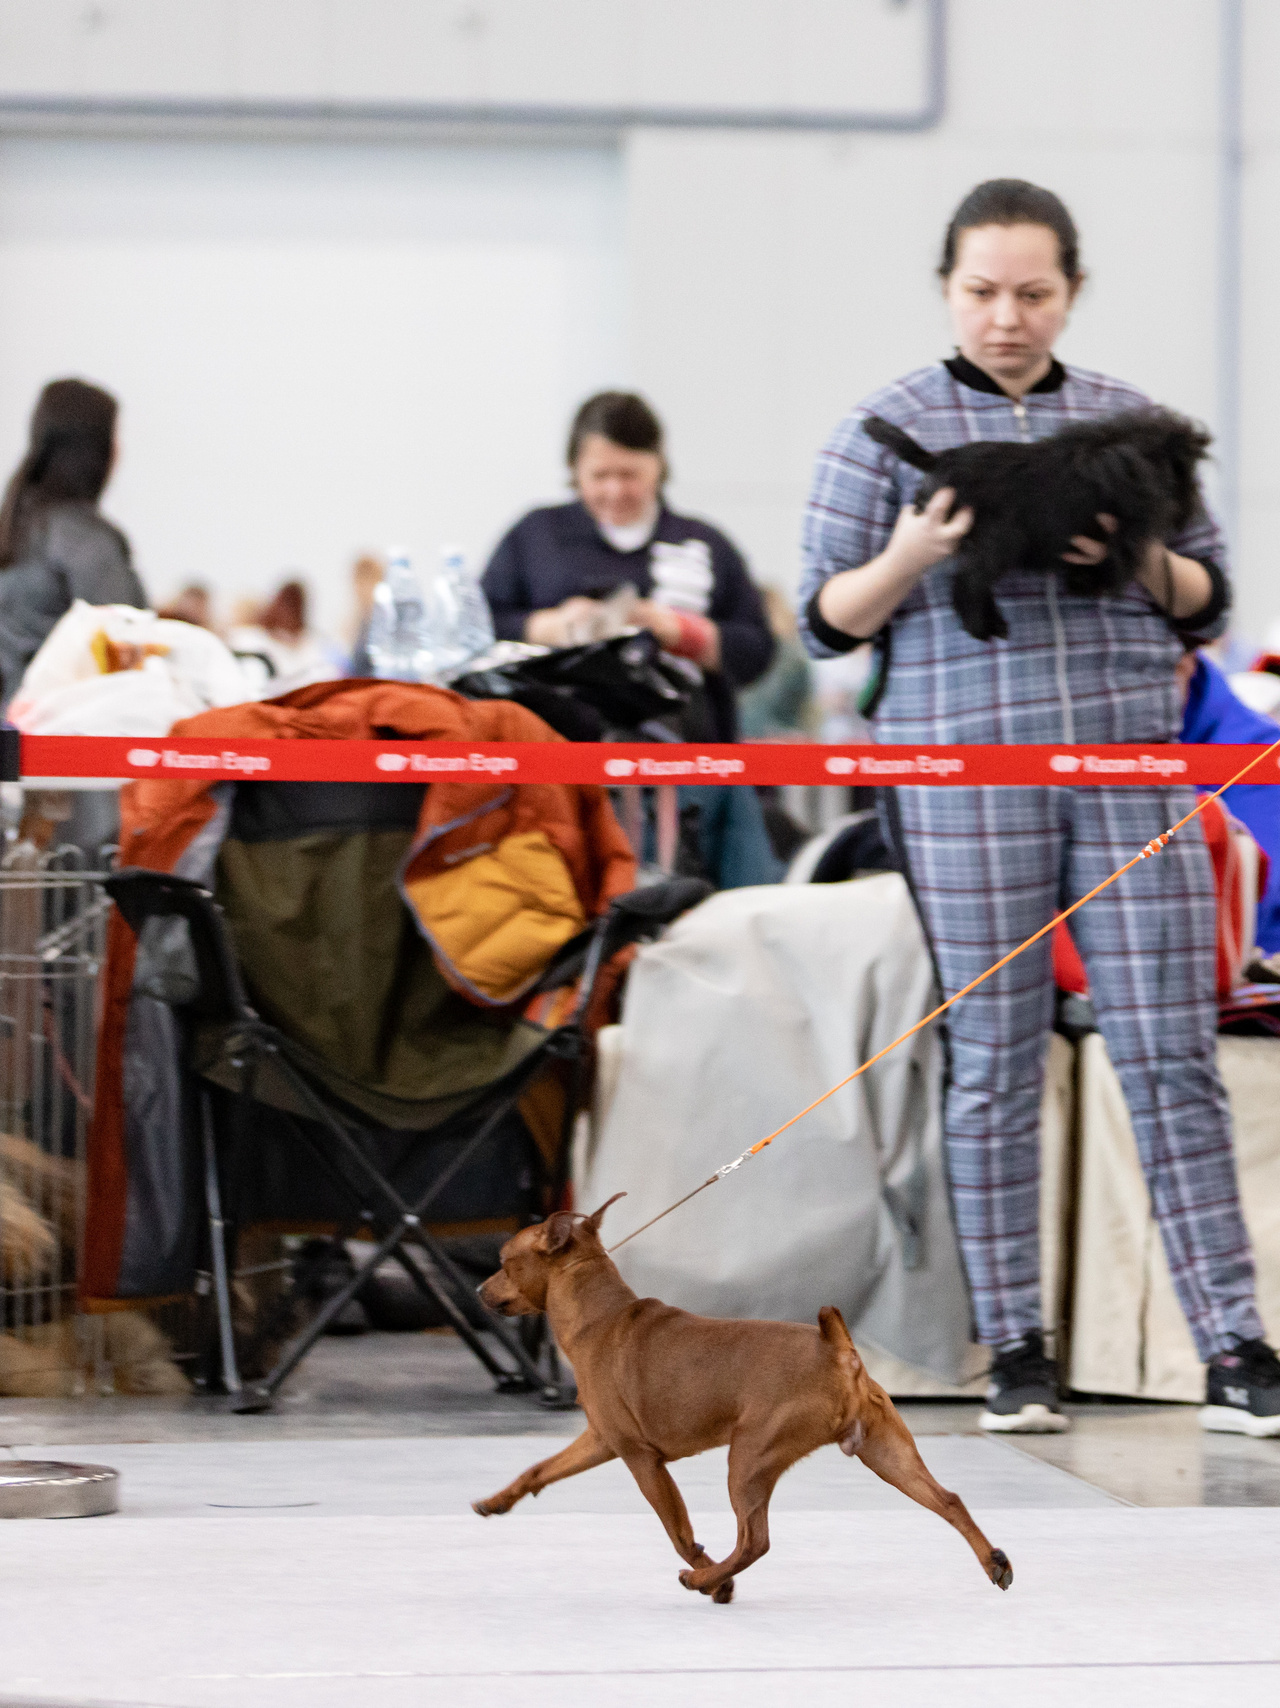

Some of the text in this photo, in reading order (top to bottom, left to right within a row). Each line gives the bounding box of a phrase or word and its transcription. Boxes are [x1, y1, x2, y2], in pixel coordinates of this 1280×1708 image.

[221, 751, 271, 775] Expo
[469, 753, 518, 775] Expo
[697, 756, 745, 777] Expo
[916, 755, 964, 777] Expo
[1139, 755, 1187, 777] Expo
